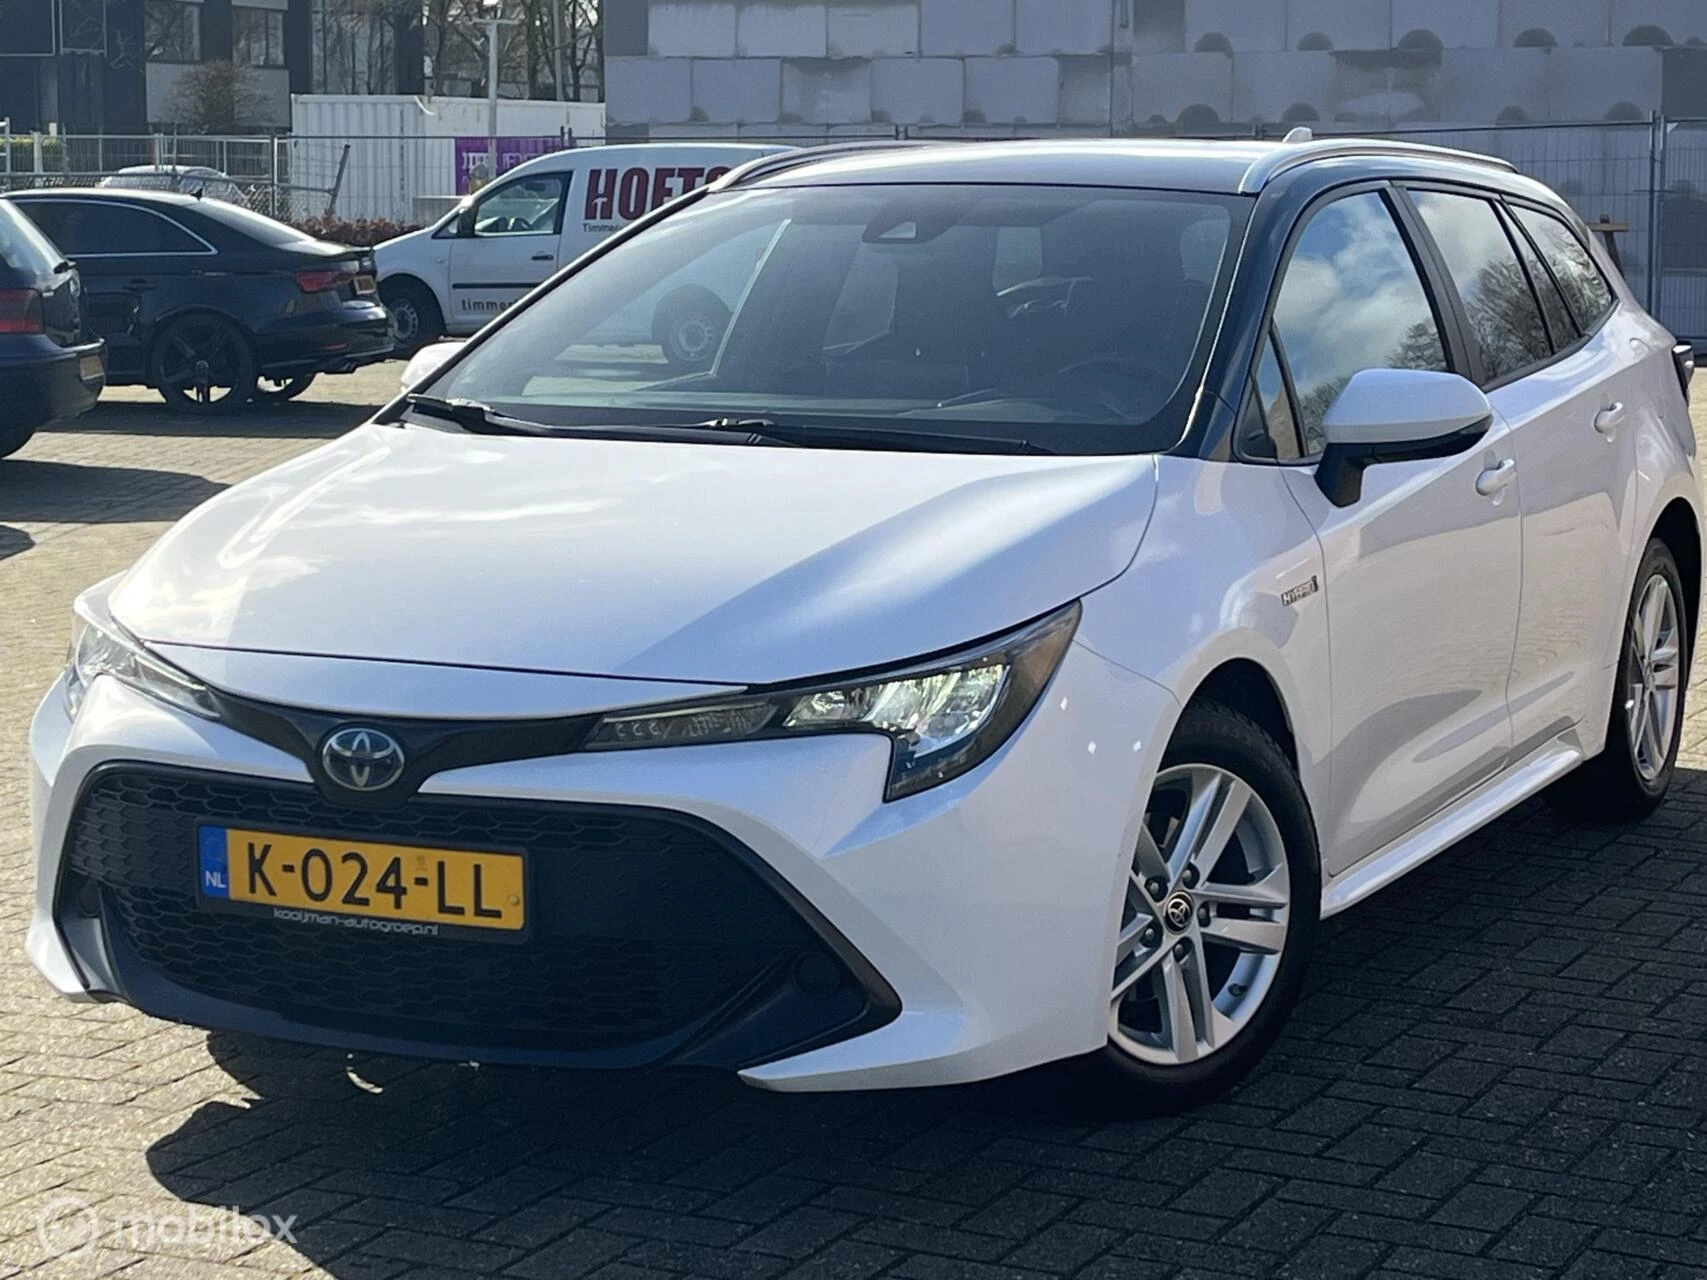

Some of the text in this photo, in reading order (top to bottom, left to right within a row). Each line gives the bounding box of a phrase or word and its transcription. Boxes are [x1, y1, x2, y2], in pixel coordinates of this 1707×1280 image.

[205, 870, 227, 888] NL
[247, 842, 503, 919] K-024-LL
[273, 907, 438, 936] kooijman-autogroep.nl
